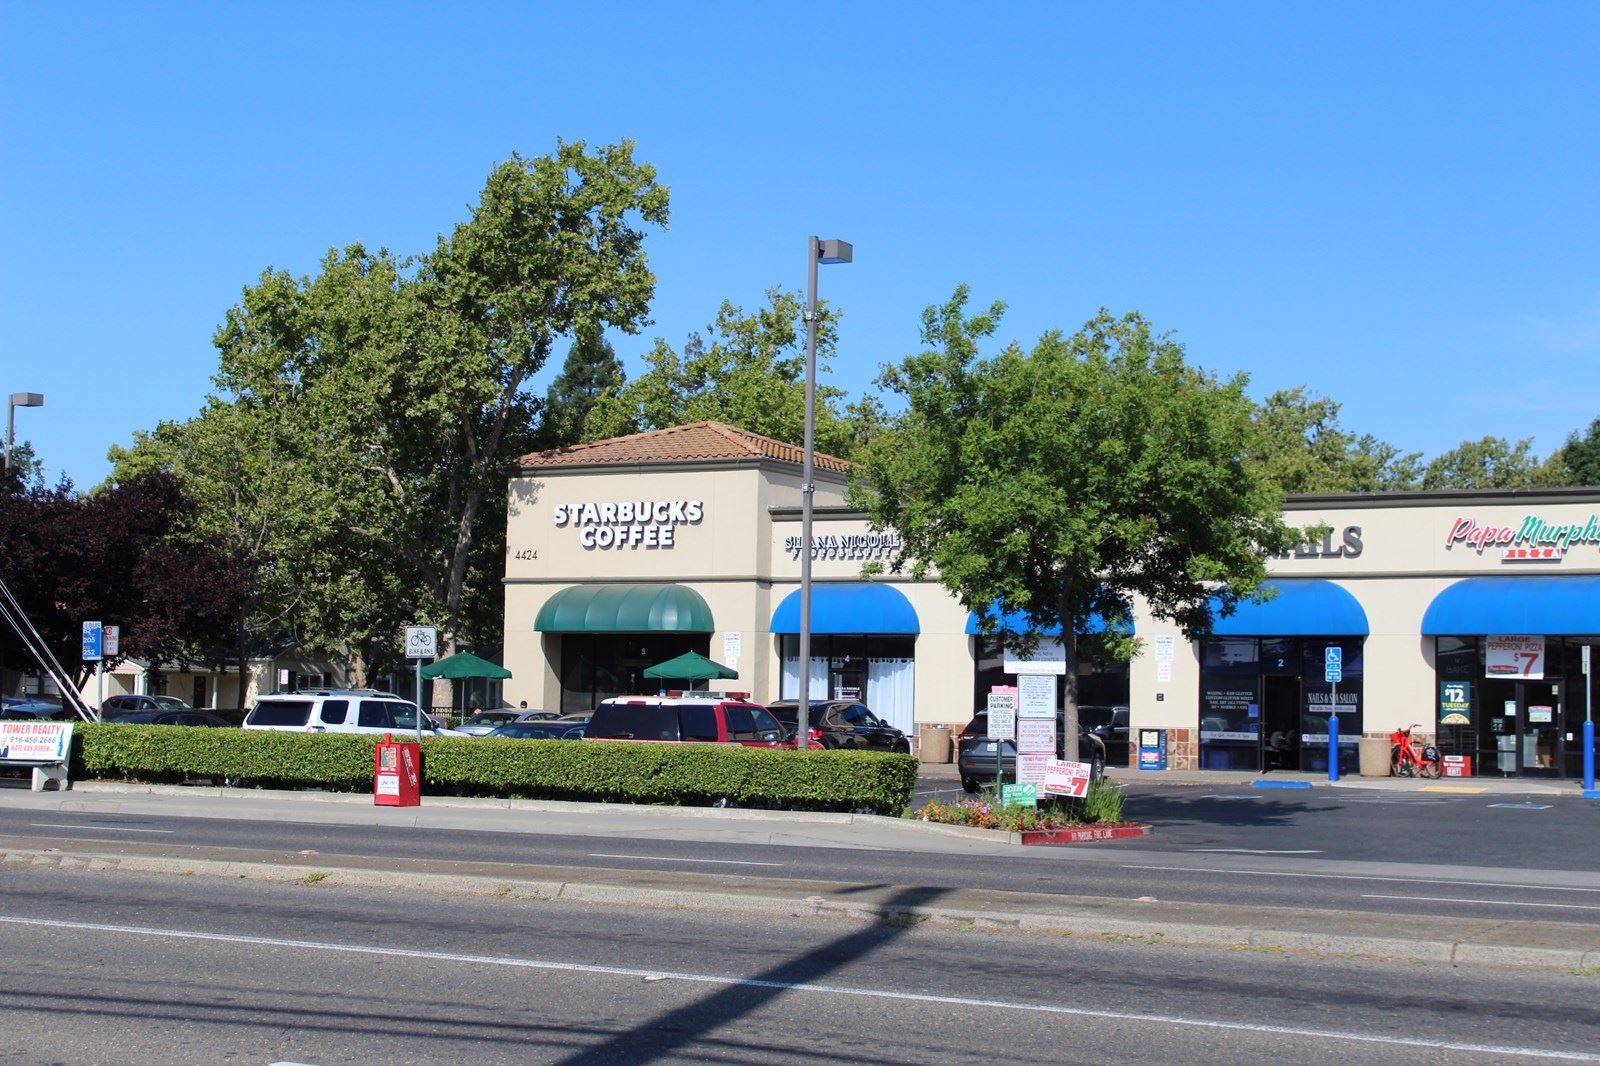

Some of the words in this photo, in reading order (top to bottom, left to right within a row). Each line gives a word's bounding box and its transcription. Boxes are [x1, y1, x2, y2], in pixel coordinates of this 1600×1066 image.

[553, 500, 703, 526] STARBUCKS
[579, 525, 675, 548] COFFEE
[1446, 517, 1515, 552] Papa
[841, 533, 901, 549] NICOLE
[515, 549, 538, 560] 4424
[792, 547, 893, 559] POTOGRAPHY
[1502, 549, 1559, 558] PIZZA
[1488, 642, 1520, 650] PEPPERONI
[1525, 642, 1543, 651] PIZZA
[1278, 658, 1285, 667] 2
[990, 695, 1013, 703] CUSTOMER
[1308, 693, 1324, 703] NAILS
[1324, 693, 1329, 703] &
[1329, 693, 1339, 703] SA
[1340, 693, 1358, 704] SALON
[1445, 688, 1464, 703] $12
[3, 724, 31, 734] TOWER
[32, 724, 61, 735] REALTY
[1056, 761, 1082, 770] LARGE
[1047, 765, 1073, 776] PEPPERONI
[1076, 768, 1089, 778] PIZZA
[1003, 785, 1023, 793] JOIN
[1077, 830, 1093, 841] PARKING
[1094, 829, 1102, 839] FIRE
[1103, 829, 1113, 839] LANE
